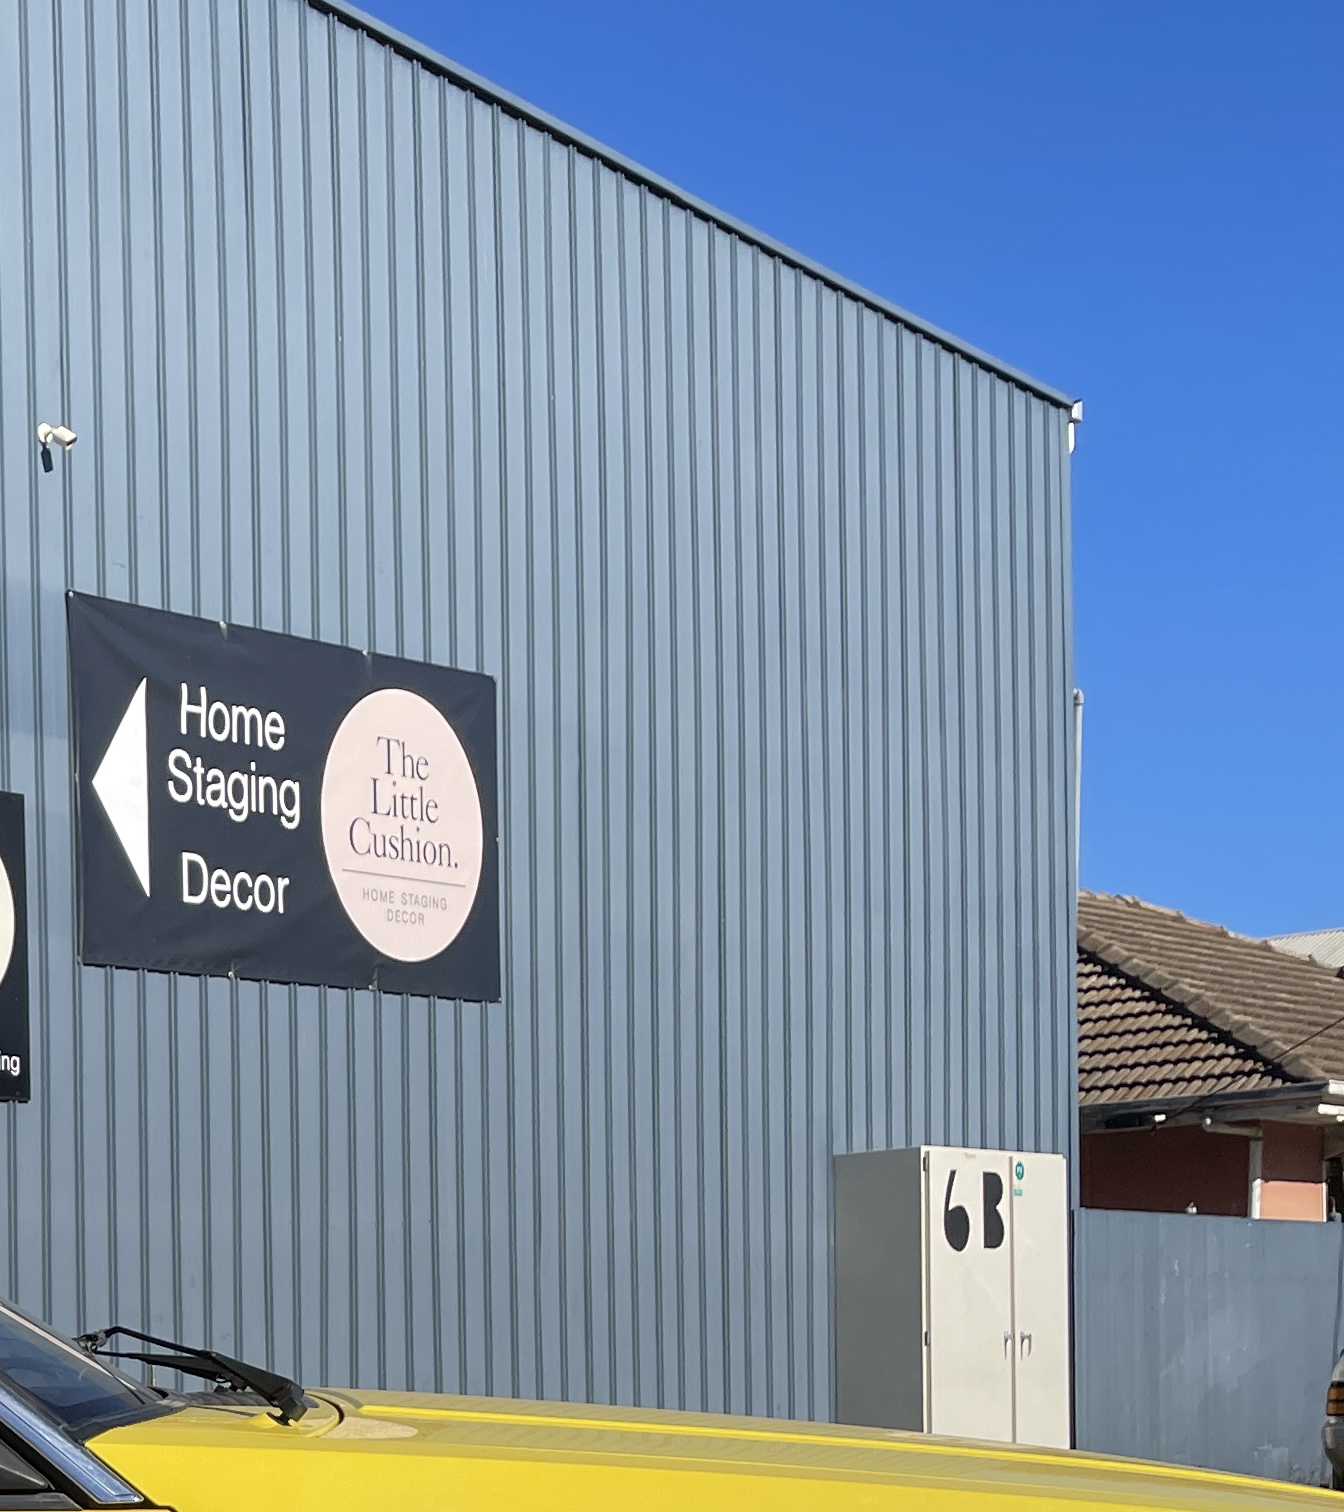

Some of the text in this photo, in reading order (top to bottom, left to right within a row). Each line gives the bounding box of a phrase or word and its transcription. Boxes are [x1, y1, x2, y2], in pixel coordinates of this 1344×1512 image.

[179, 682, 286, 751] Home
[376, 736, 430, 781] The
[167, 748, 301, 830] Staging
[370, 777, 439, 824] Little
[349, 816, 459, 869] Cushion.
[180, 851, 290, 914] Decor
[362, 887, 448, 912] HOME STAGING
[386, 908, 425, 926] DECOR
[943, 1168, 1005, 1253] 6B
